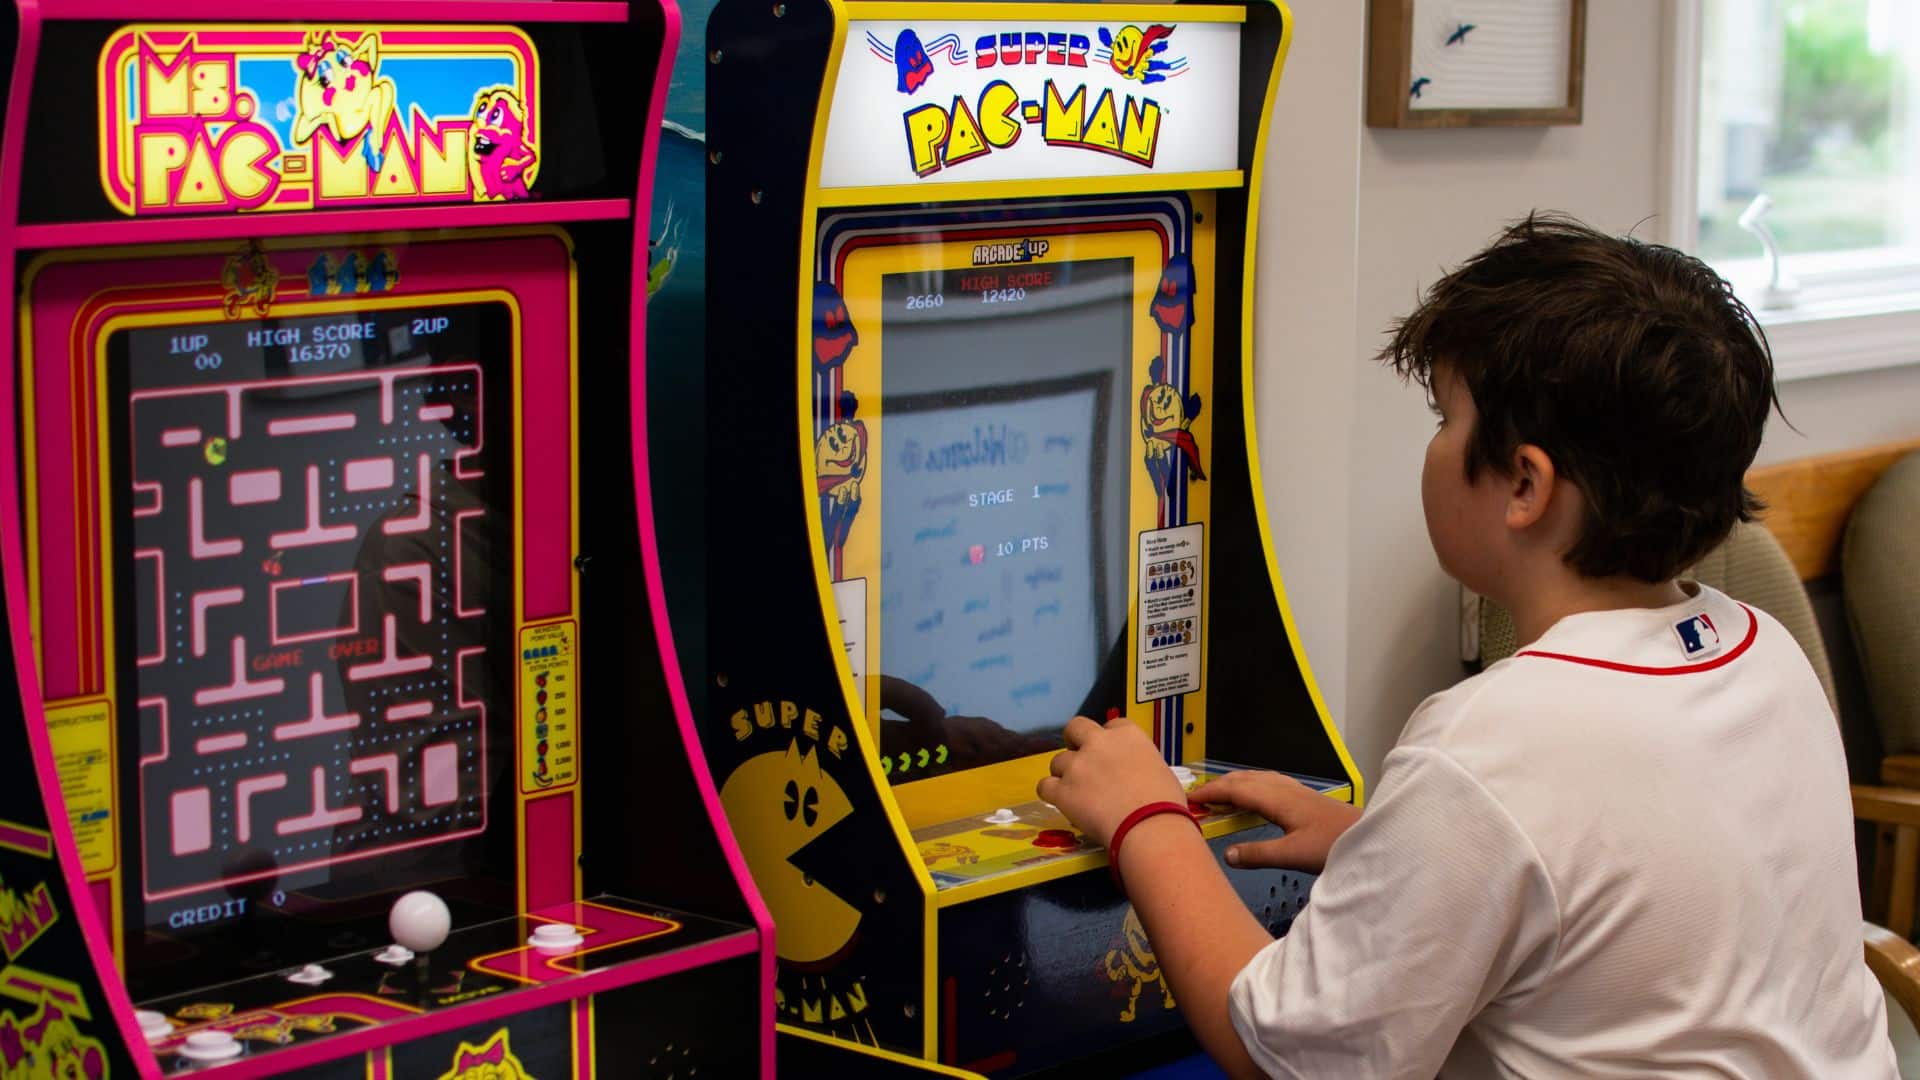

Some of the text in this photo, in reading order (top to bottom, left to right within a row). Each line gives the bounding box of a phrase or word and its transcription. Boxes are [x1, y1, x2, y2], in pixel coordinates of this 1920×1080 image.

[976, 31, 1091, 69] SUPER
[138, 37, 257, 120] Ms.
[903, 78, 1162, 179] PAC-MAN
[136, 112, 473, 210] PAC-MAN
[961, 271, 1053, 291] HIGH SCORE
[906, 287, 1026, 310] 2660 12420
[170, 317, 449, 354] 1UP HIGH SCORE 2UP
[194, 343, 351, 370] 00 16370
[968, 488, 1015, 507] STAGE
[1032, 485, 1041, 499] 1
[996, 536, 1049, 557] 10 PTS
[252, 638, 378, 672] GAME OVER
[731, 700, 848, 760] SUPER
[169, 898, 248, 929] CREDIT
